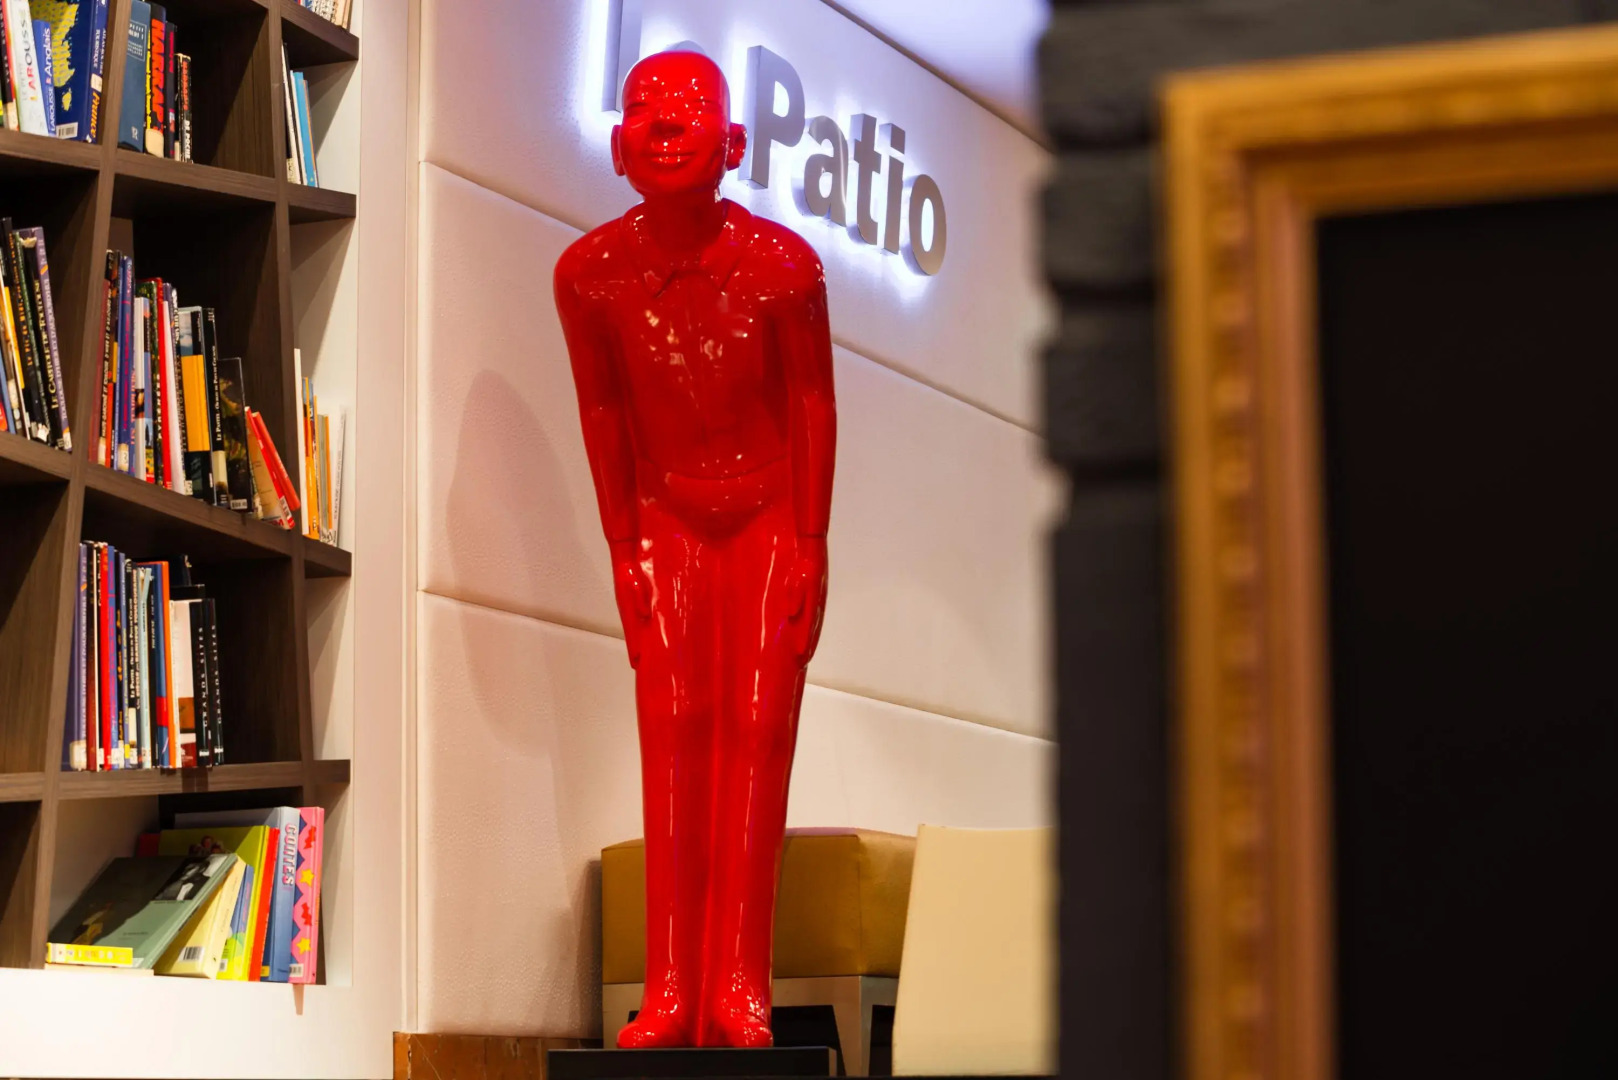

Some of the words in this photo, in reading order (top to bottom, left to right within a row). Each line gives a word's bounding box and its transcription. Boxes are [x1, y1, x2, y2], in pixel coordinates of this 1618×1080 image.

[19, 9, 38, 101] LAROUSSE
[43, 27, 52, 77] Anglais
[48, 87, 56, 131] LAROUSSE
[90, 92, 100, 138] France
[185, 119, 191, 131] DE
[738, 45, 947, 276] Patio
[34, 279, 46, 329] TOULOUSE
[52, 339, 58, 350] ET
[42, 346, 57, 394] CAPITOLE
[58, 378, 68, 420] TOULOUSE
[214, 670, 222, 724] GRANDS
[281, 823, 297, 886] CONTES
